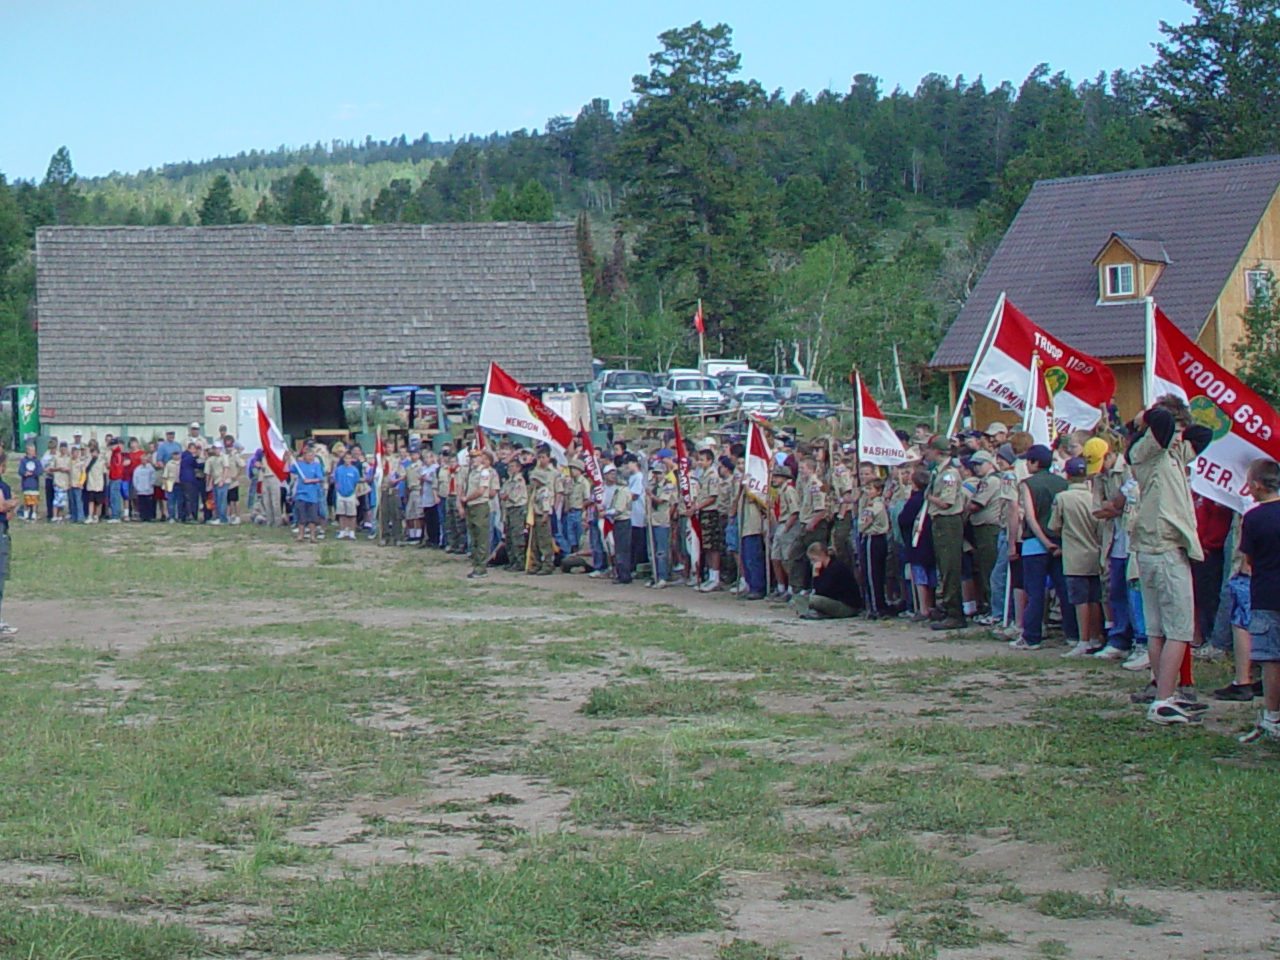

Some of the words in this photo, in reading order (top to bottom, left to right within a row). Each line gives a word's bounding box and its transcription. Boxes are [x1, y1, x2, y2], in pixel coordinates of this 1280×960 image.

[1034, 332, 1063, 361] TROOP
[1066, 356, 1093, 375] 1199
[1178, 351, 1237, 405] TROOP
[1233, 404, 1272, 441] 633
